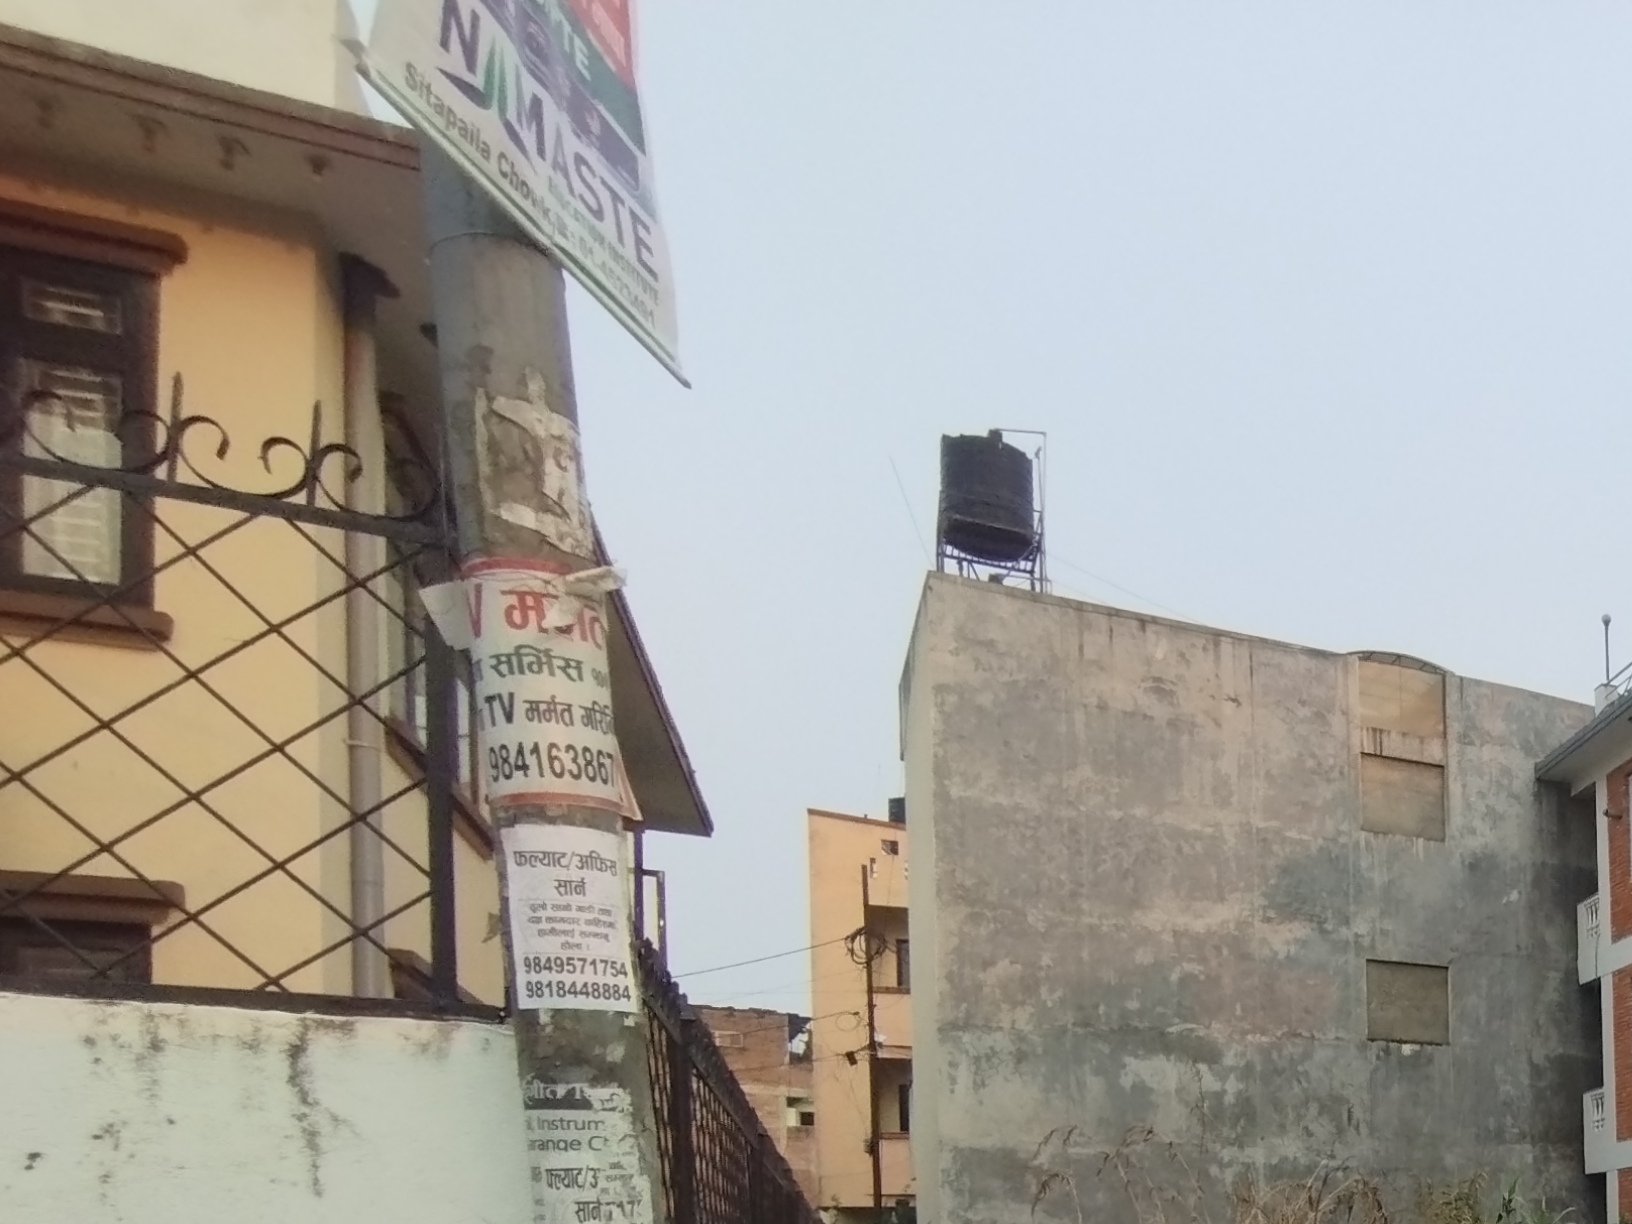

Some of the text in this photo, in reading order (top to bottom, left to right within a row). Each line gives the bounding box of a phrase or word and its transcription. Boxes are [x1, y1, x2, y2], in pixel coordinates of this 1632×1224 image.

[405, 61, 491, 165] Sitapaila
[484, 692, 515, 728] TV
[523, 955, 629, 979] 9849571754
[525, 980, 631, 1002] 9818448884
[537, 1117, 606, 1132] Instrum
